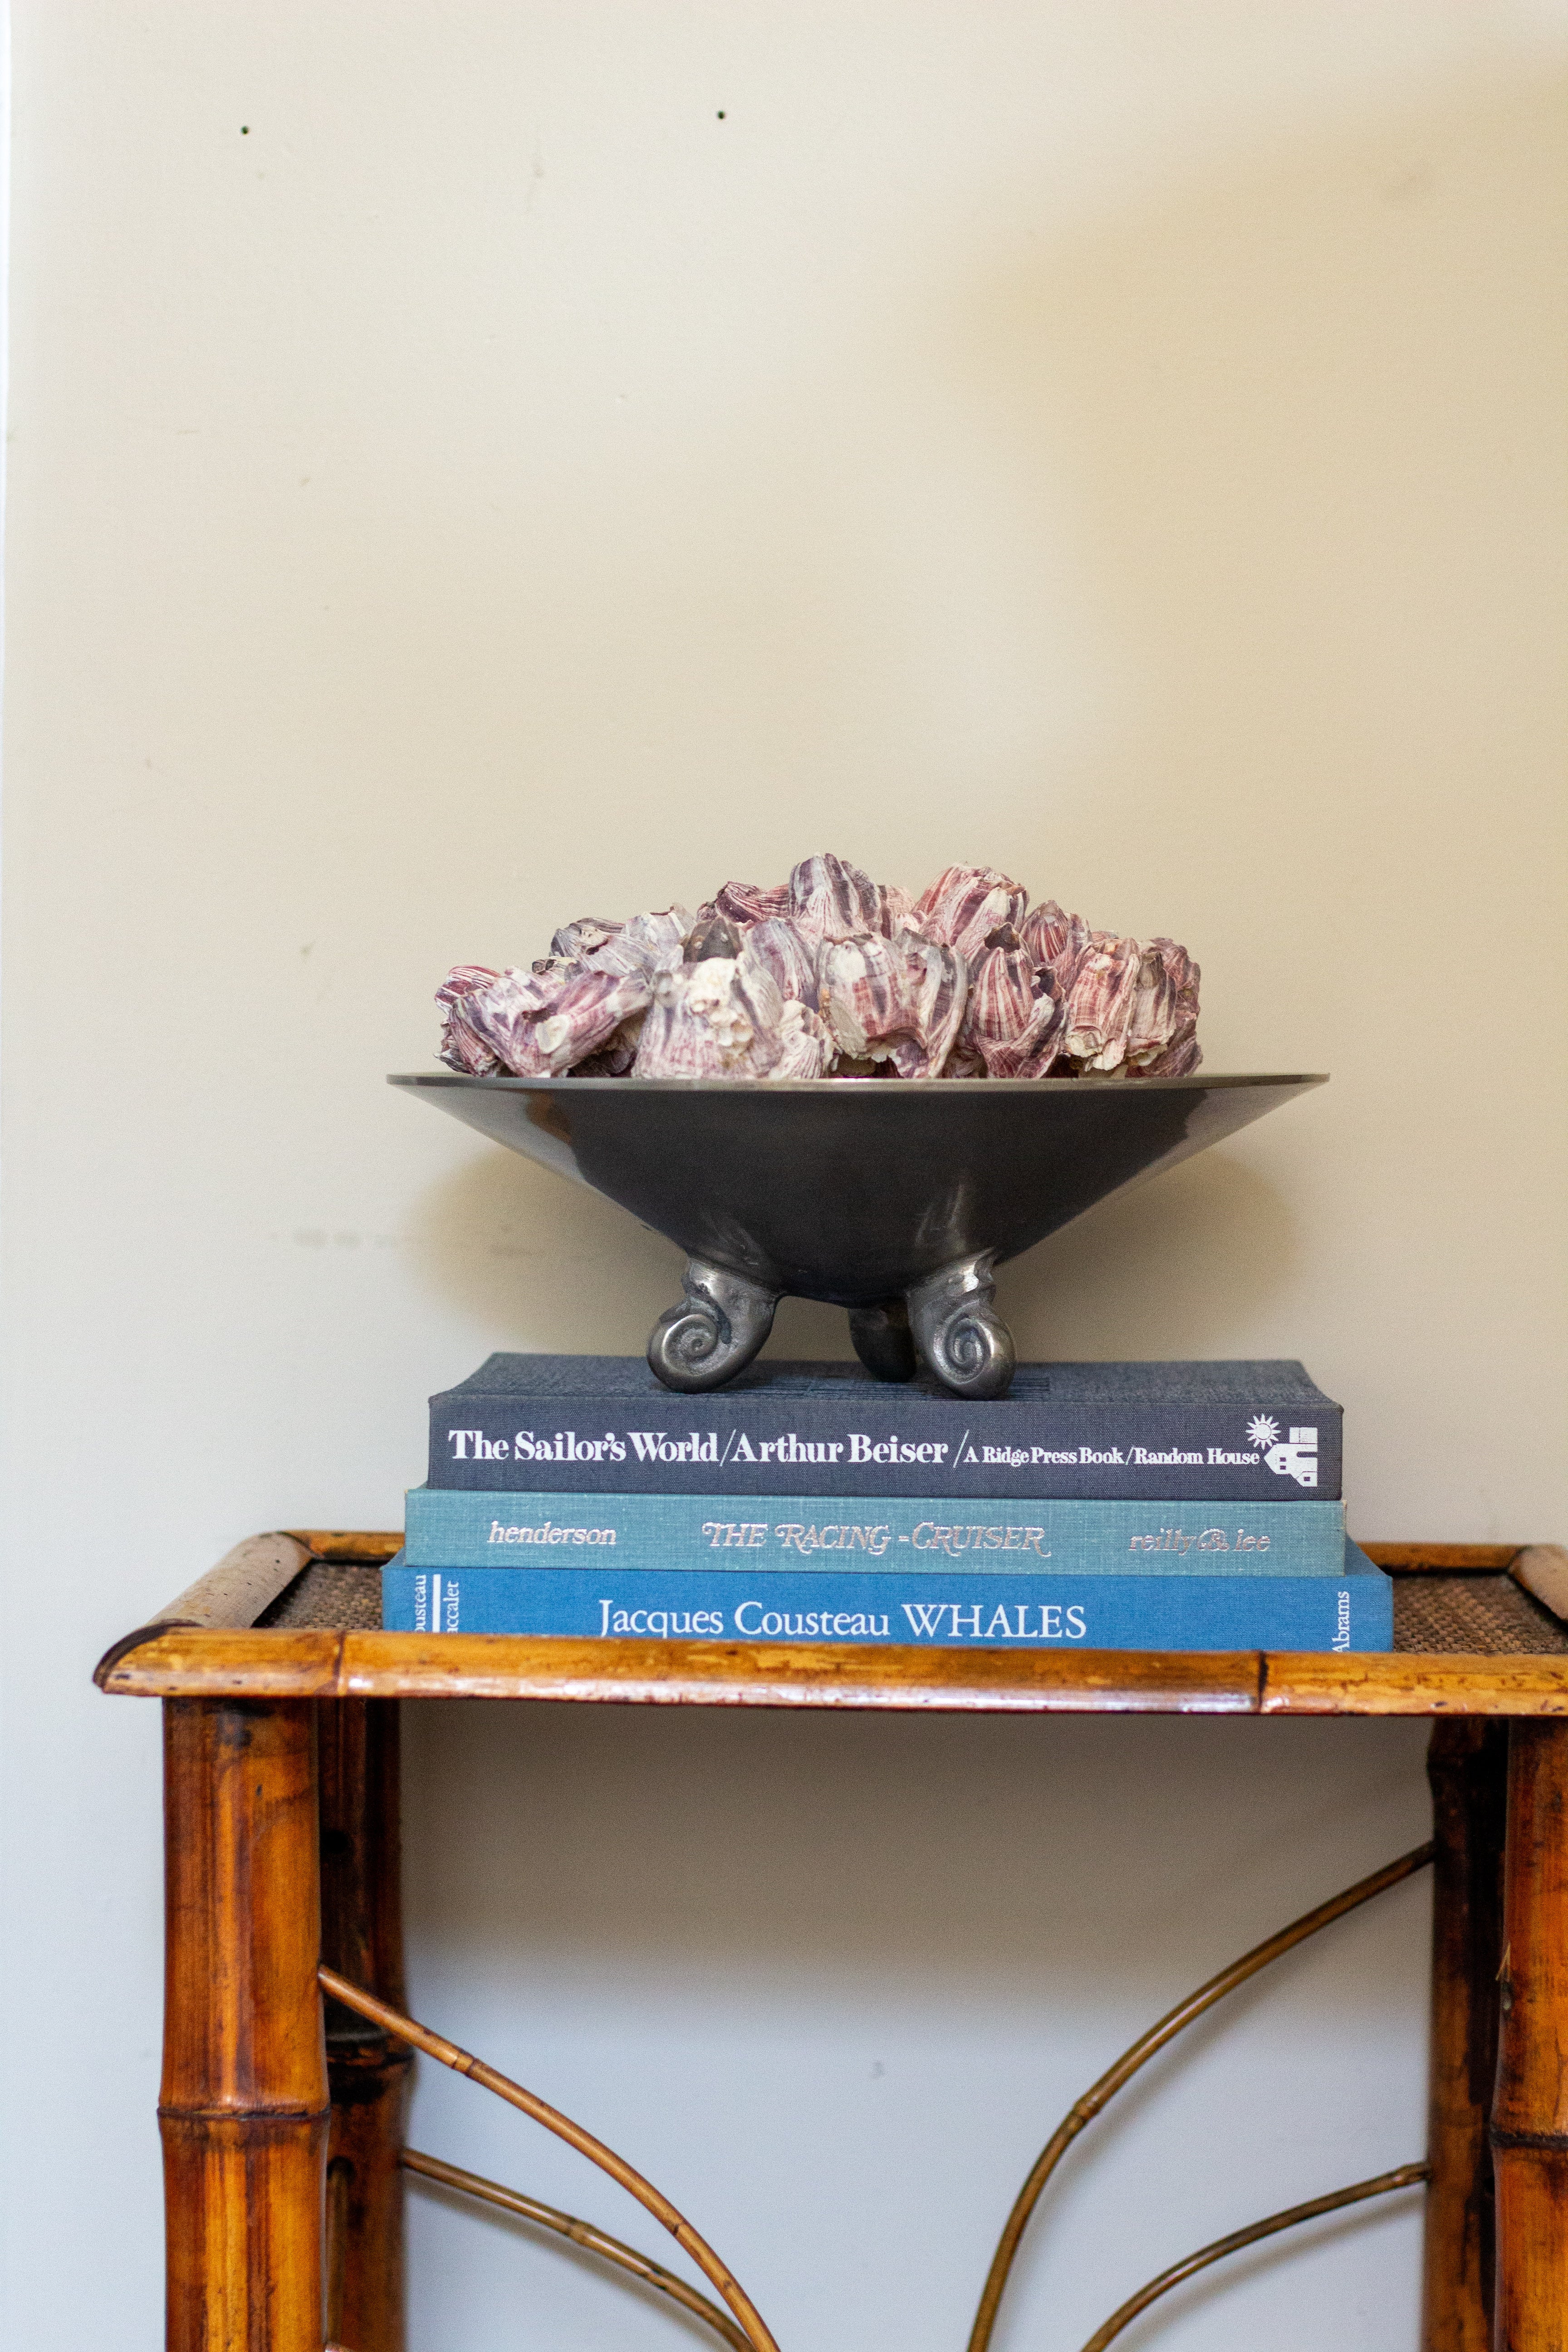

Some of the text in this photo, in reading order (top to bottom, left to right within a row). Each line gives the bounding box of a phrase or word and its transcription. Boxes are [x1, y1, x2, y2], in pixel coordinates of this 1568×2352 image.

[448, 1430, 509, 1460] The
[514, 1431, 626, 1462] Sailor's
[983, 1446, 1029, 1467] Ridge
[1031, 1447, 1078, 1464] Press
[1206, 1448, 1260, 1465] House
[487, 1520, 617, 1544] henderson
[701, 1522, 768, 1546] THE
[1128, 1528, 1197, 1555] reilly
[415, 1574, 426, 1632] ousteau
[599, 1599, 1087, 1639] Jacques Cousteau WHALES
[1332, 1591, 1350, 1652] Abrams
